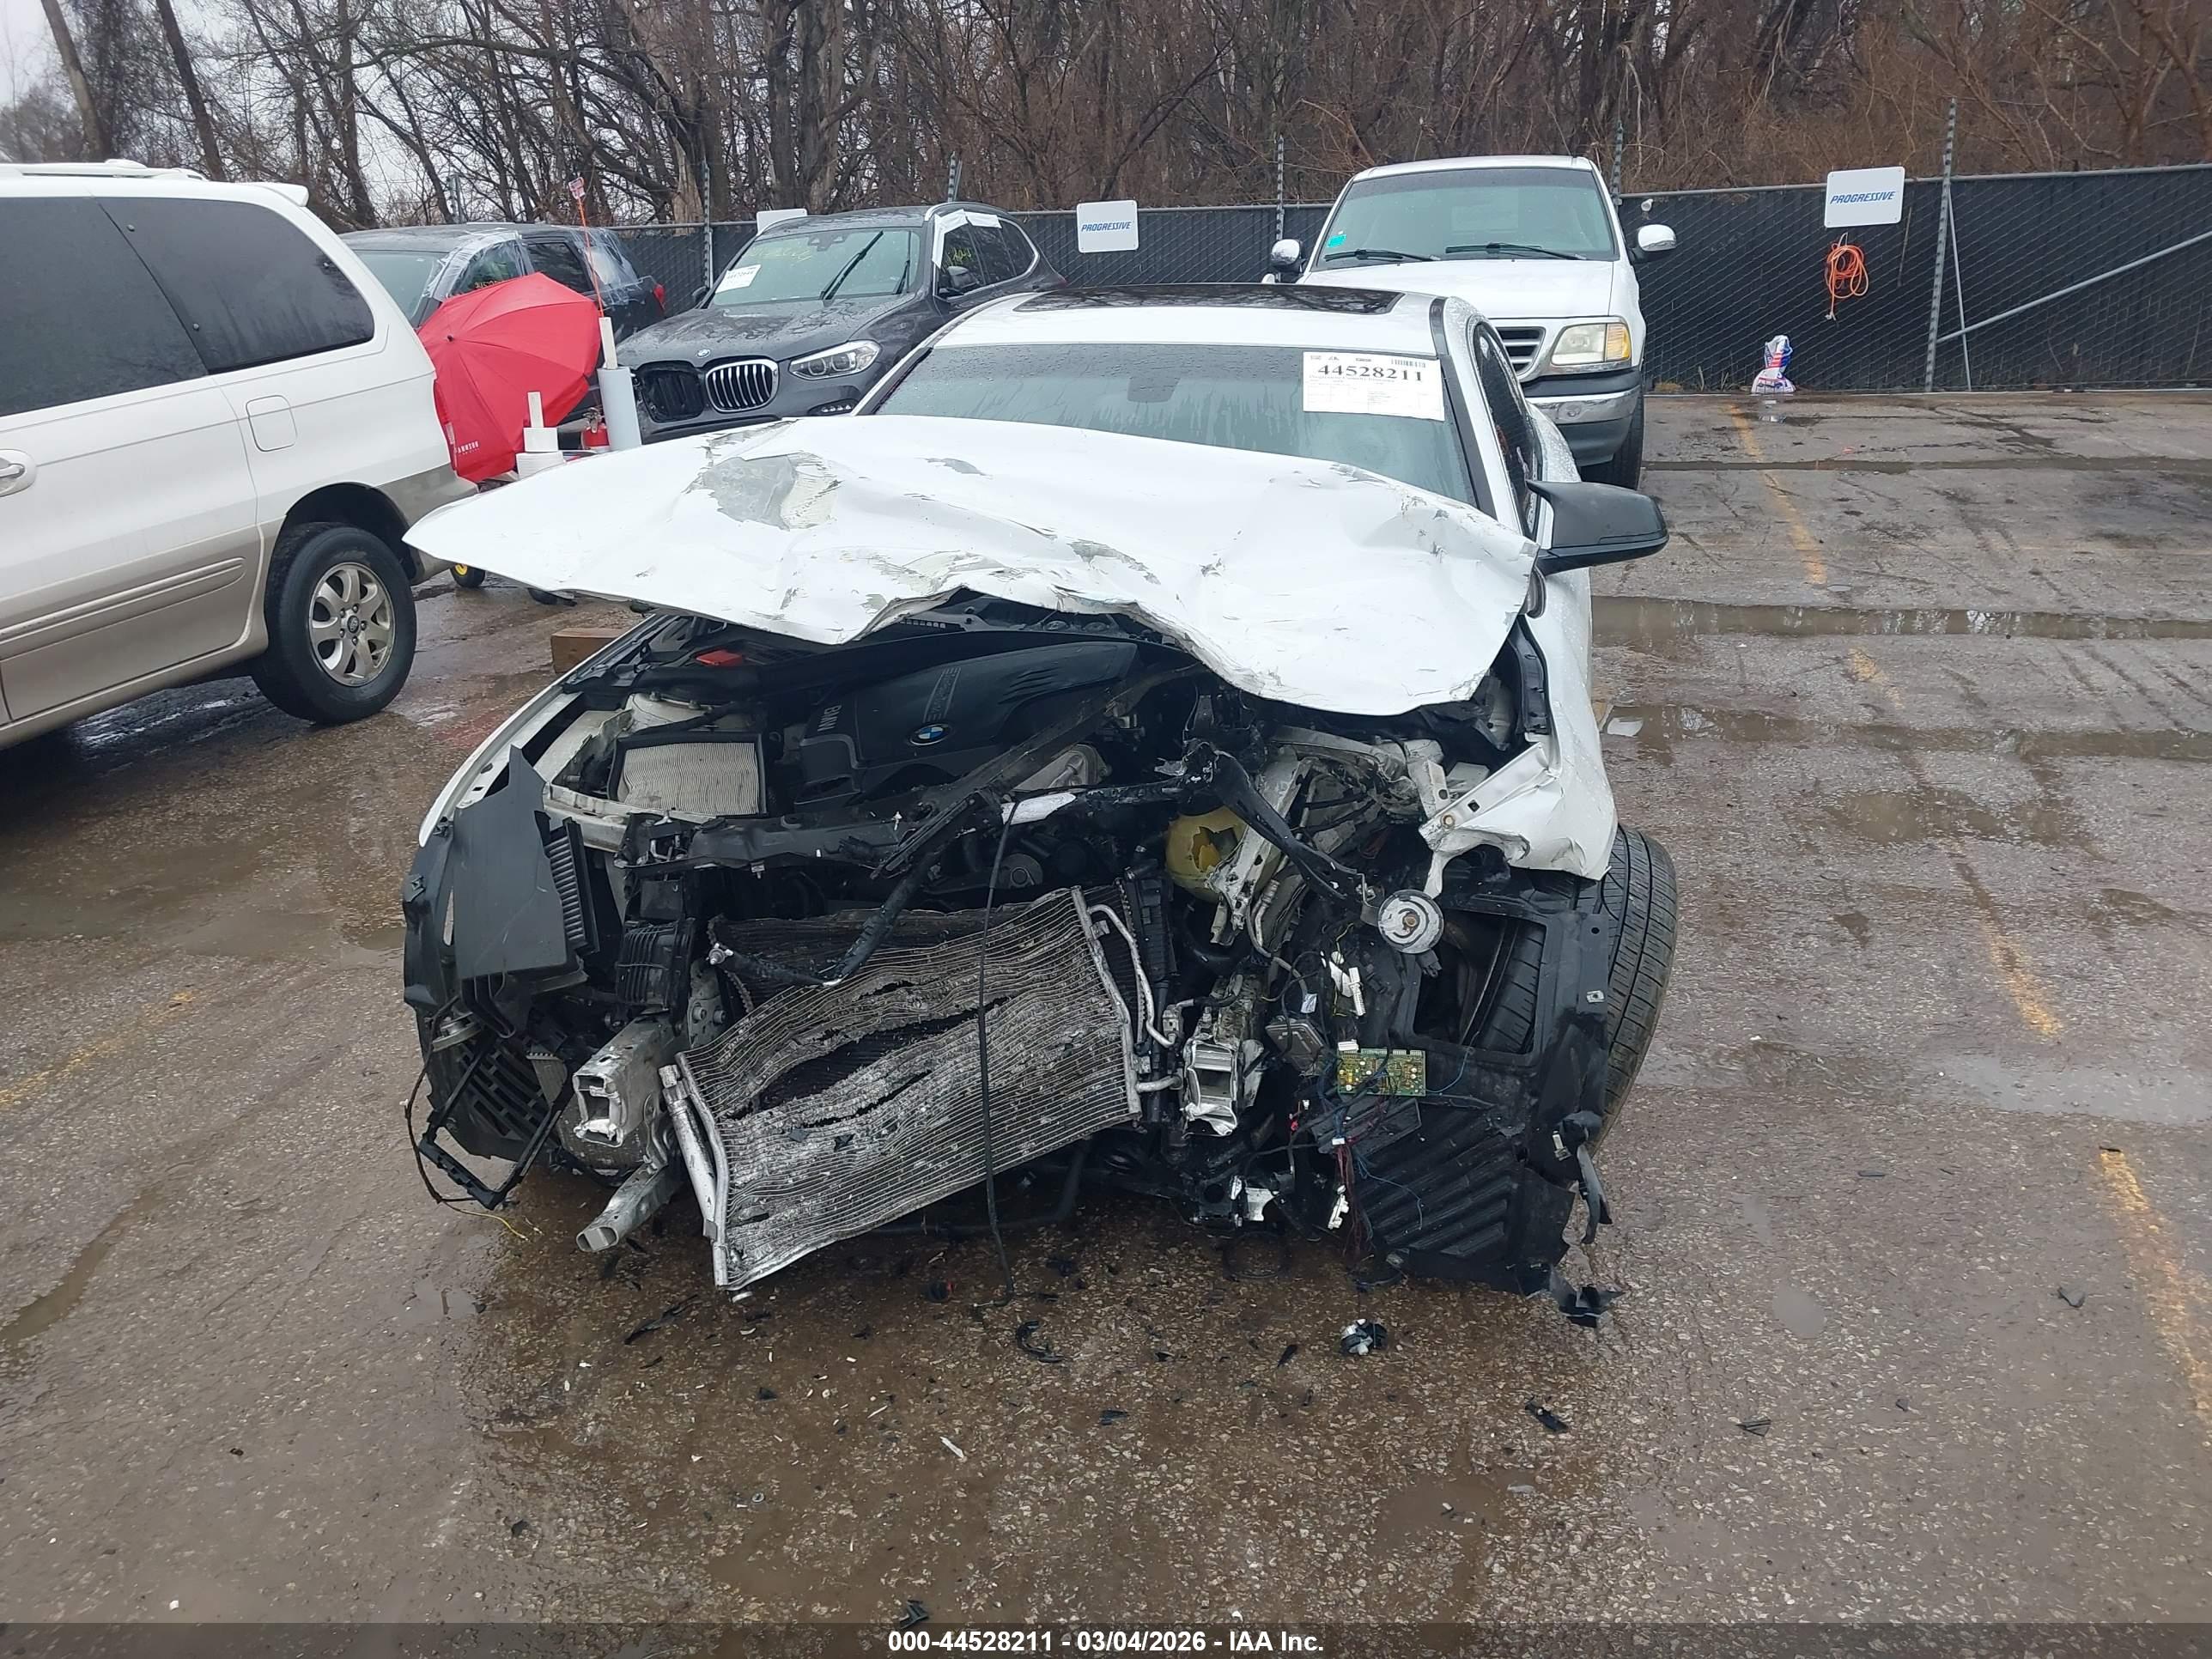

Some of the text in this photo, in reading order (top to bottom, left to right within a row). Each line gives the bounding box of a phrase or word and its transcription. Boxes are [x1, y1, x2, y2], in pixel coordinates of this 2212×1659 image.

[1830, 191, 1896, 204] PROGRESSIVE
[1081, 222, 1132, 232] PROGRESSIVE
[1317, 364, 1422, 381] 44528211
